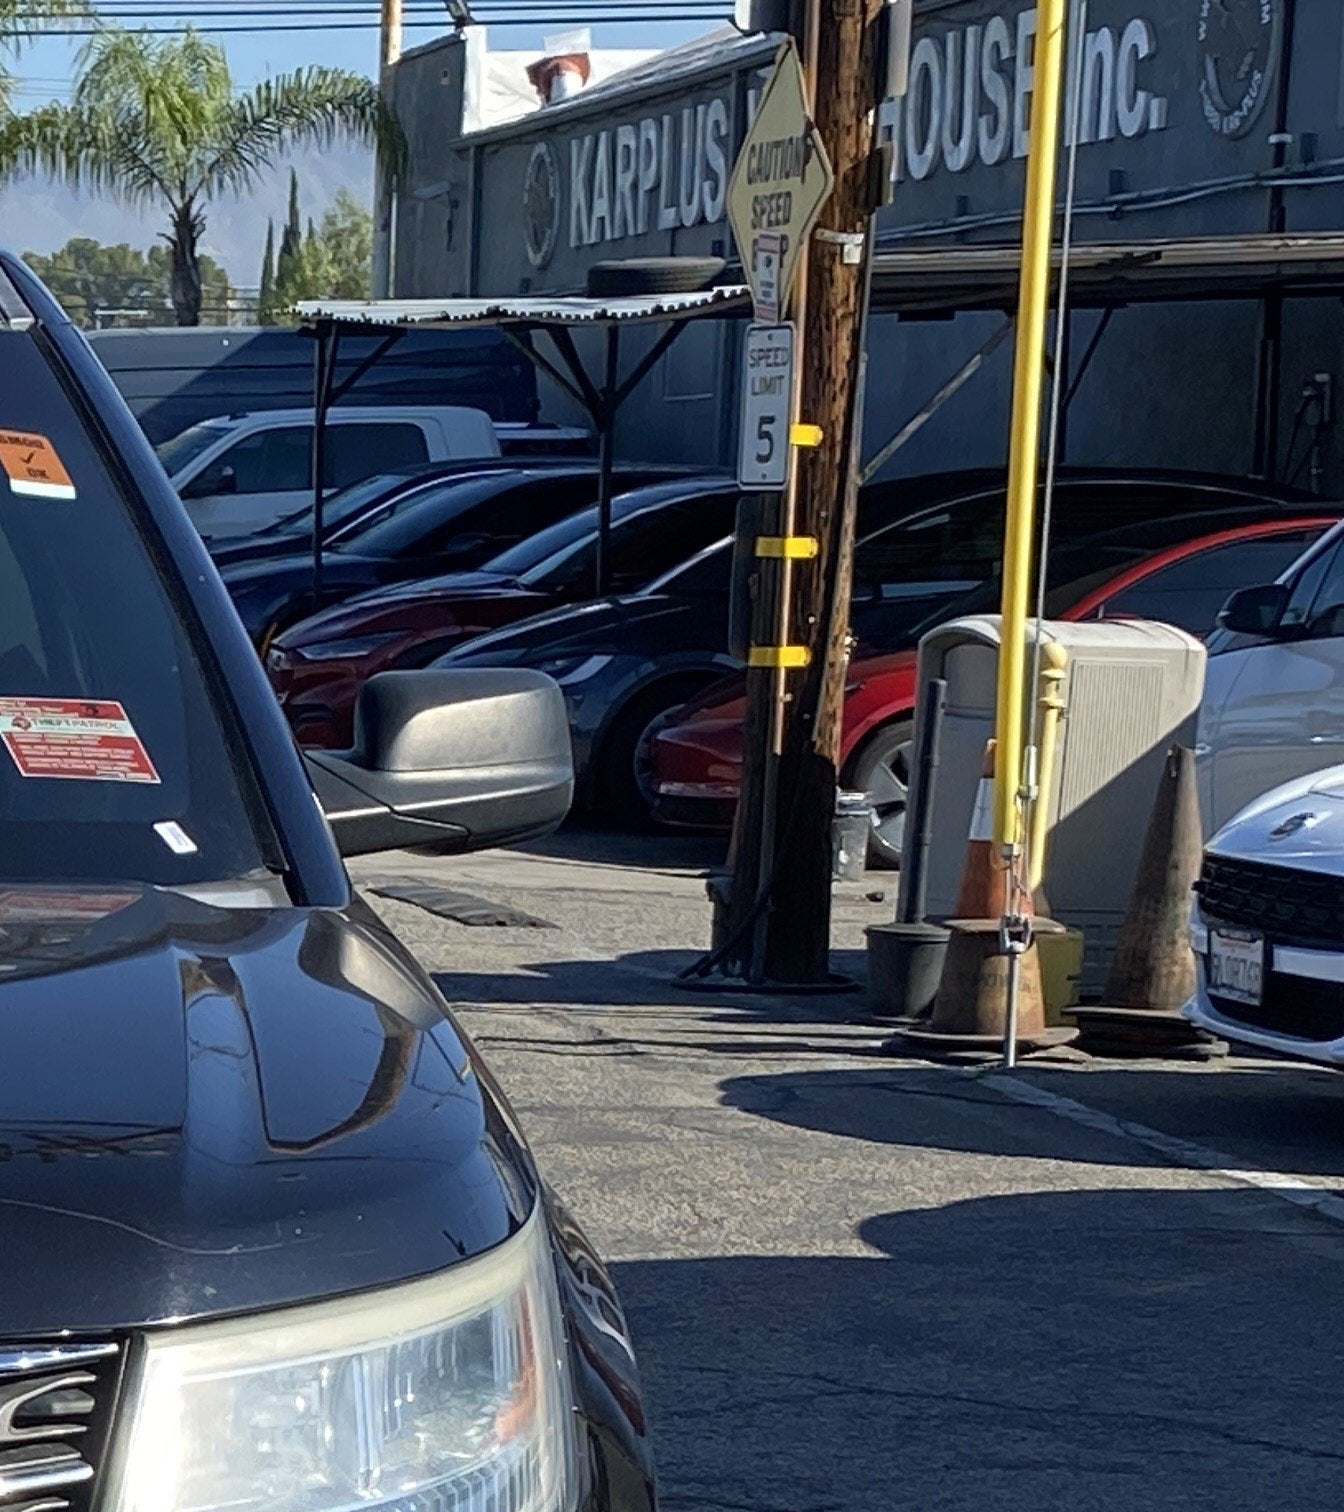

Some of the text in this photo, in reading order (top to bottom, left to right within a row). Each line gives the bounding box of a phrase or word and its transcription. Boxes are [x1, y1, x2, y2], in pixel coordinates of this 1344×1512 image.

[569, 98, 728, 248] KARPLUS
[747, 136, 805, 185] CAUTION
[751, 191, 792, 230] SPEED
[749, 347, 789, 368] SPEED
[751, 375, 785, 396] LIMIT
[755, 415, 776, 464] 5
